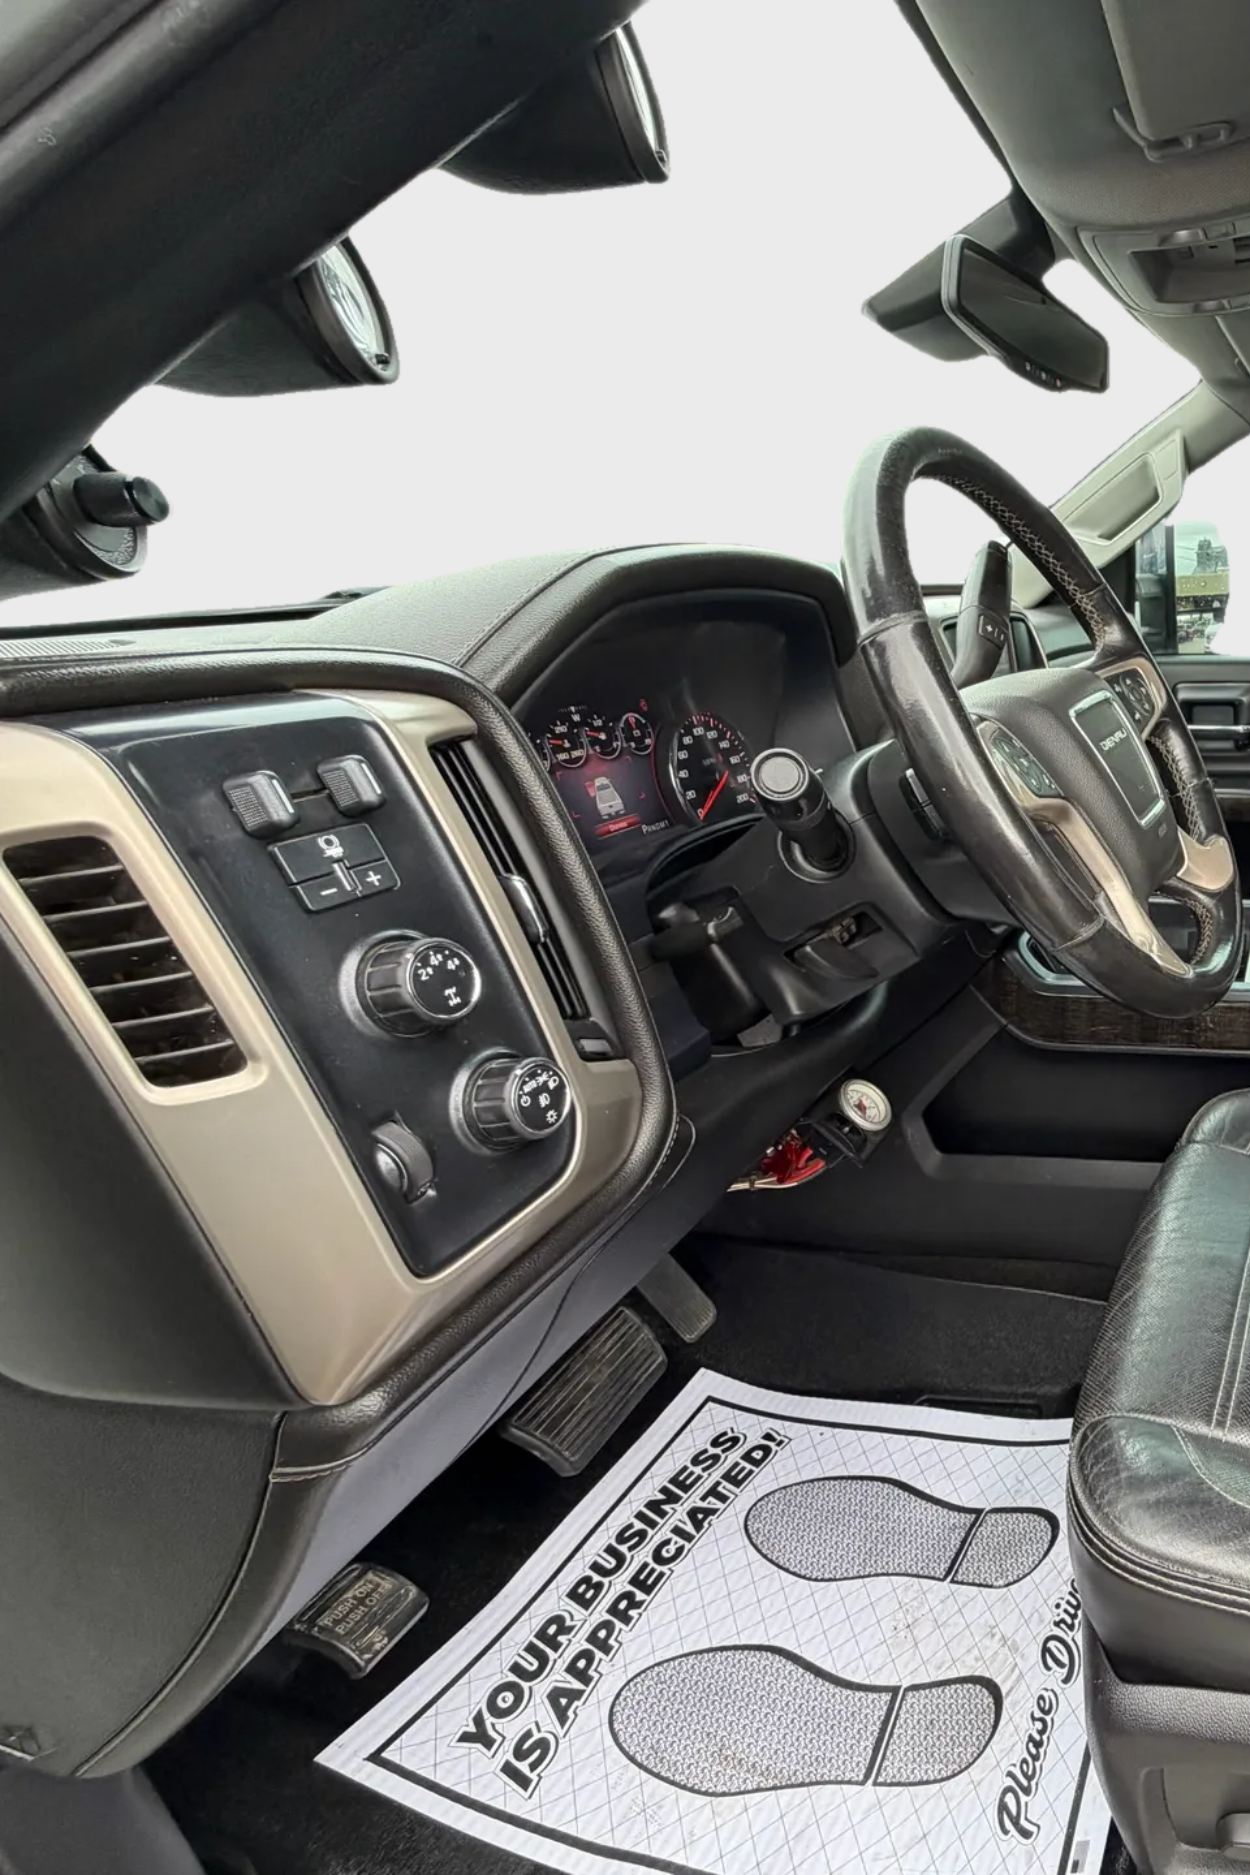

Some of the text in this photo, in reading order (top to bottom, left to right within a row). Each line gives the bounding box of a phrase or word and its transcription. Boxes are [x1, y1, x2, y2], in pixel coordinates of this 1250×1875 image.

[692, 726, 706, 737] 100
[706, 729, 719, 739] 120
[682, 735, 694, 746] 80
[729, 755, 741, 765] 160
[677, 769, 690, 779] 40
[685, 789, 697, 800] 20
[736, 793, 750, 804] 200
[456, 1429, 744, 1753] YOUR BUSINESS
[323, 1581, 374, 1627] PUSH ON
[499, 1430, 785, 1793] IS APPRECIATED!
[335, 1605, 368, 1635] PUSH
[998, 1689, 1055, 1840] Please
